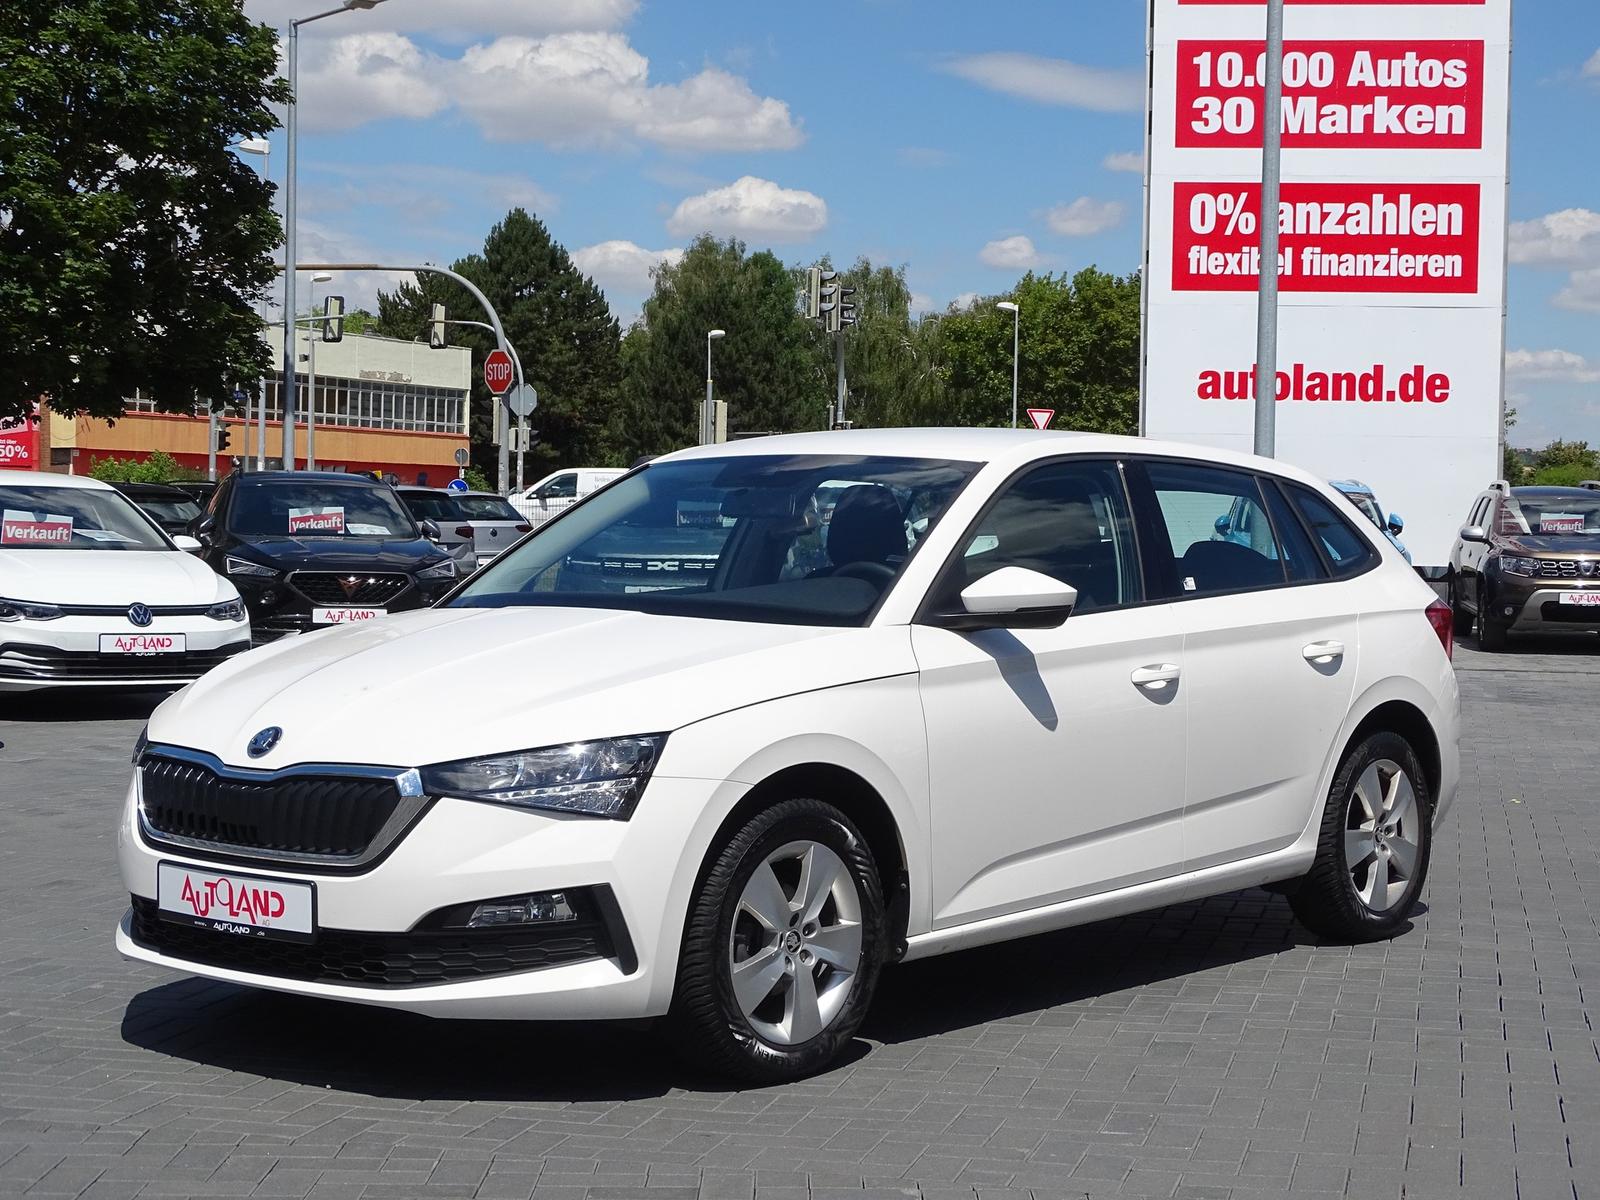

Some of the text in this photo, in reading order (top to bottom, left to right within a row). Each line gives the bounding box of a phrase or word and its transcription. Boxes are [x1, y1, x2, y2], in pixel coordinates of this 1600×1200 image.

[1346, 50, 1467, 88] Autos
[1191, 95, 1466, 135] 30 Marken
[1190, 192, 1463, 236] 0% anzahlen
[1301, 247, 1462, 278] finanzieren
[487, 363, 510, 381] STOP
[291, 516, 342, 531] Verkauft
[1541, 521, 1583, 531] Verkauft
[5, 525, 70, 541] Verkauft
[325, 608, 376, 623] AUTOLAND
[114, 636, 172, 652] AUTOLAND
[181, 873, 285, 924] AUTOLAND
[213, 922, 250, 934] AUTOLAND
